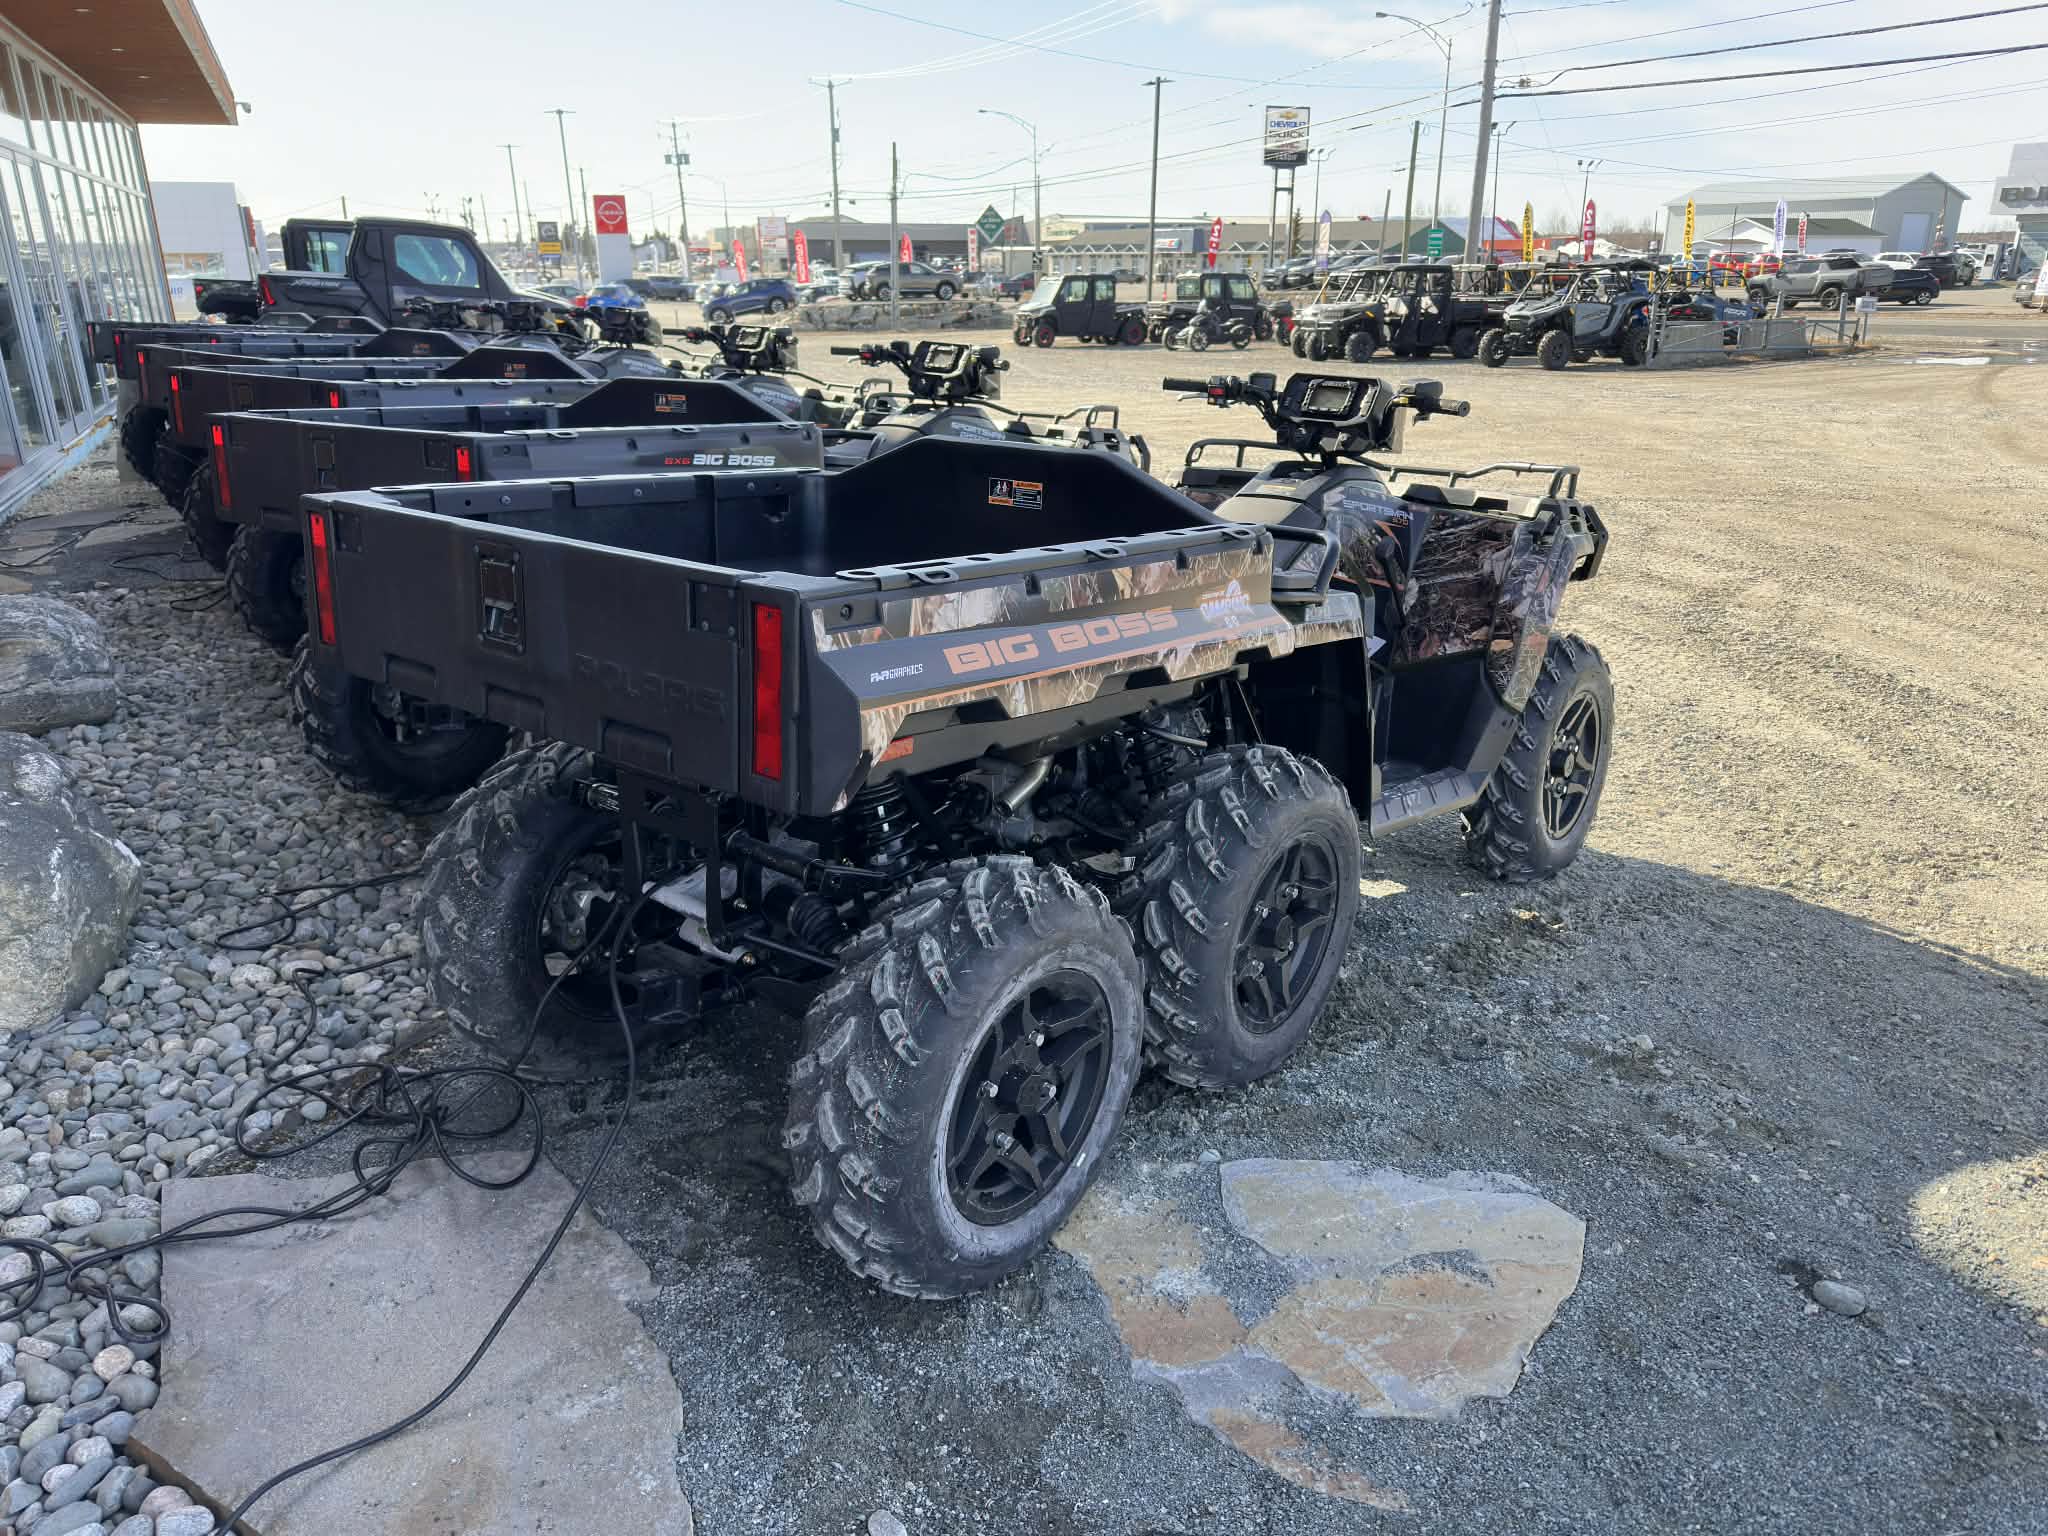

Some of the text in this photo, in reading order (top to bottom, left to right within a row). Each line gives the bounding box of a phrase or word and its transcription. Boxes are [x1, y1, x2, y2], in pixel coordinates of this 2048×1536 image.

[693, 453, 725, 466] BIG
[727, 454, 776, 467] BOSS
[1343, 500, 1414, 520] SPORTSMAN
[943, 605, 1179, 674] BIG BOSS
